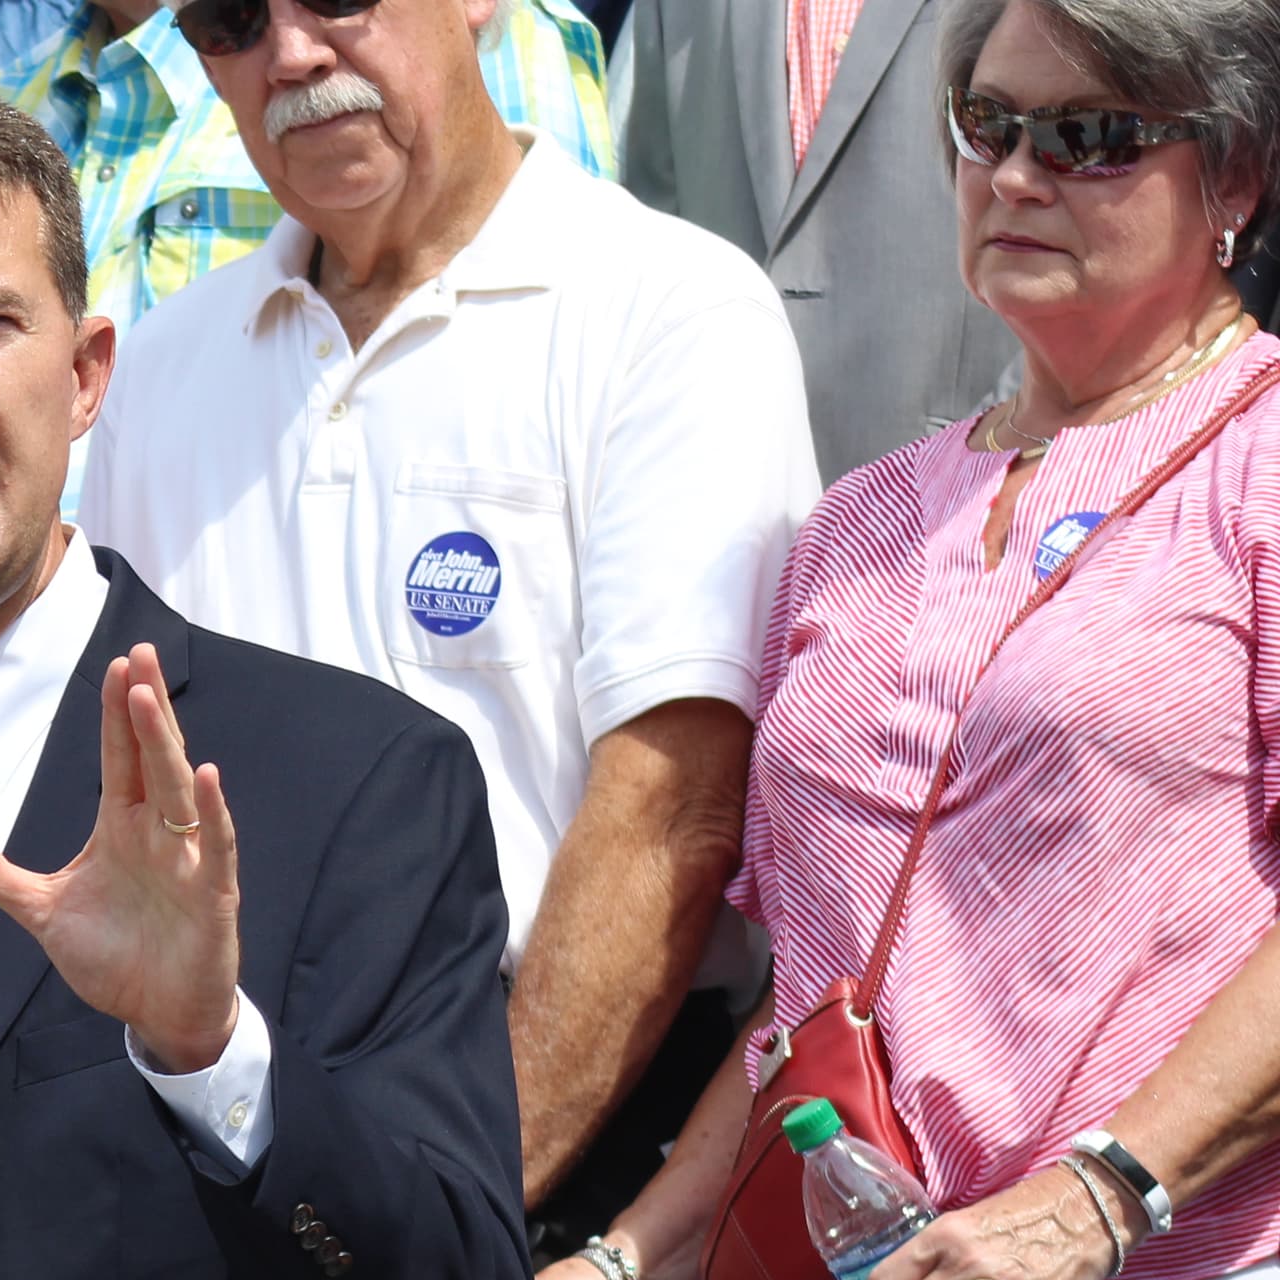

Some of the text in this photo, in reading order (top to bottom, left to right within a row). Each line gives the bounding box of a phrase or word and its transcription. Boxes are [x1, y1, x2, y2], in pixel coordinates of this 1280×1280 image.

[440, 548, 483, 572] John
[408, 558, 500, 594] Merrill
[410, 591, 490, 615] US SENATE
